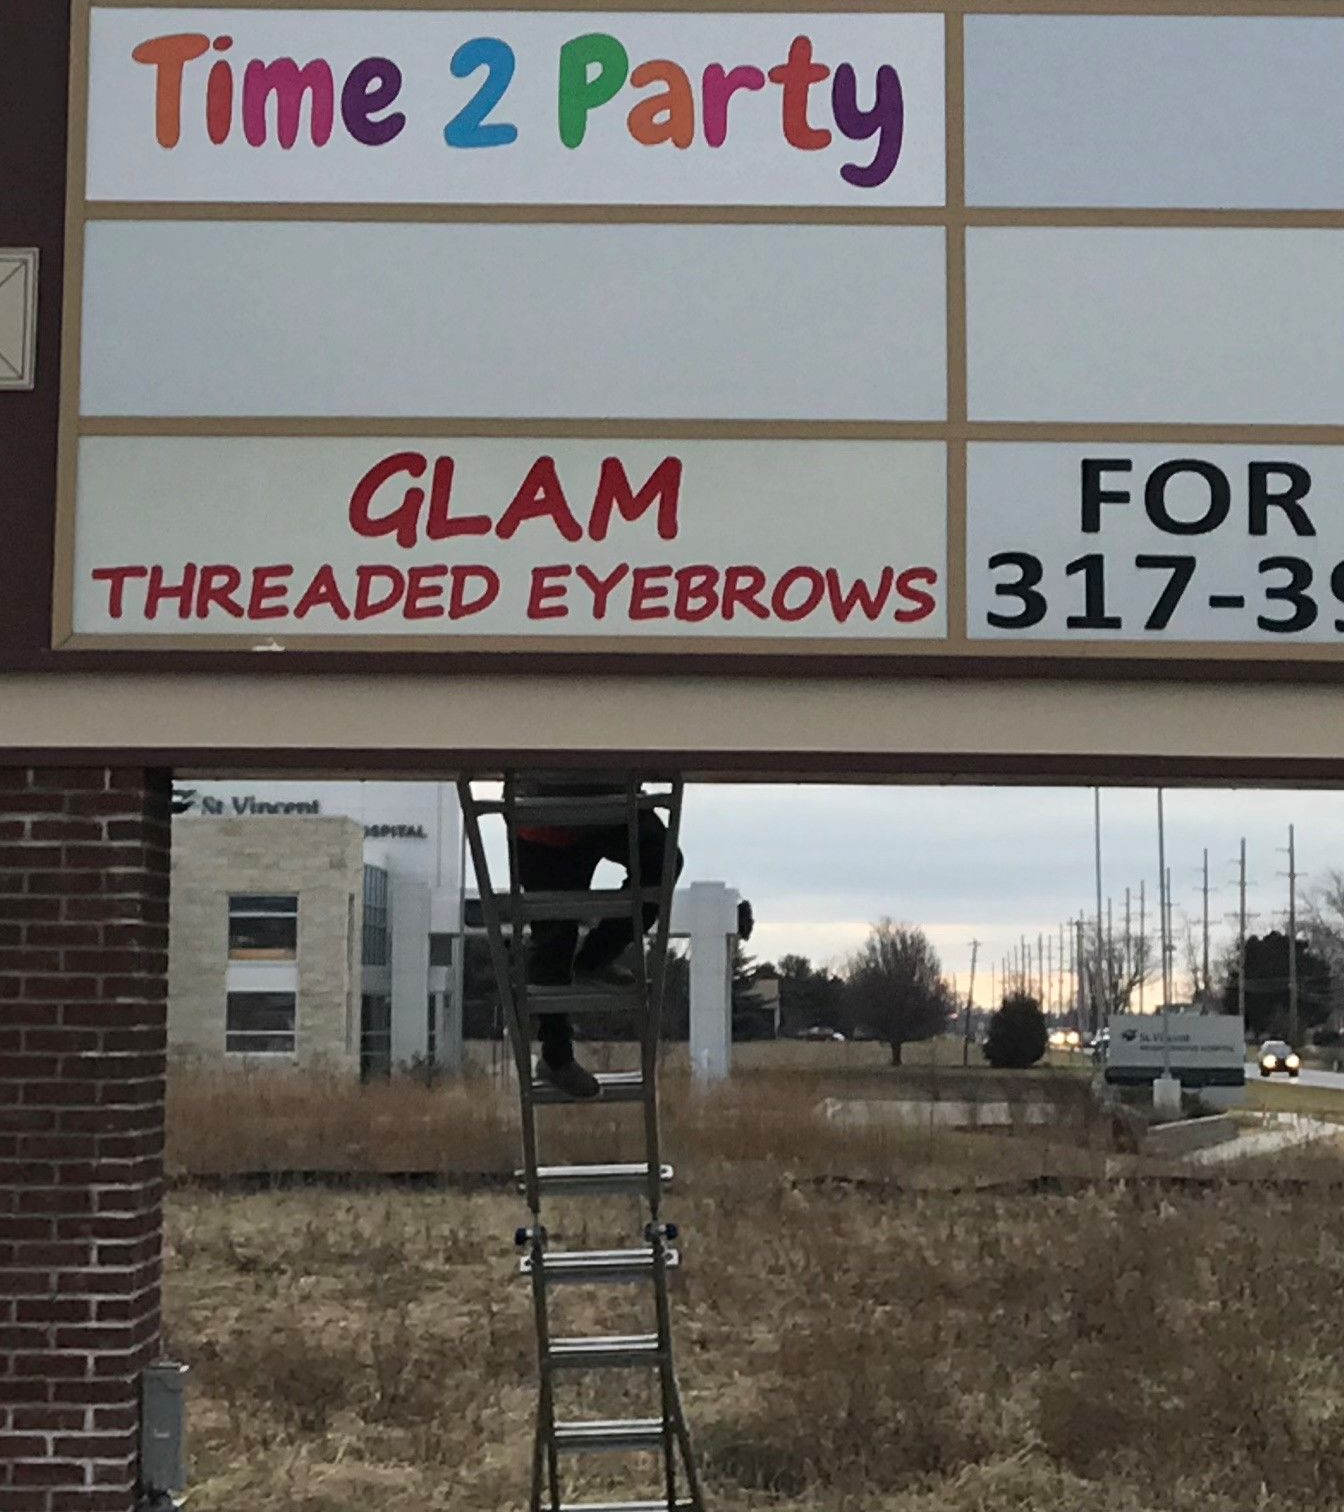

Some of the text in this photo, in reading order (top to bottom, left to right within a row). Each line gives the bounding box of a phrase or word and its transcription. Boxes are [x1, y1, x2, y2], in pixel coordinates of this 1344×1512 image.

[132, 33, 904, 188] Time 2 Party
[349, 452, 682, 548] GLAM
[1081, 459, 1316, 536] FOR
[92, 563, 937, 623] THREADED EYEBROWS
